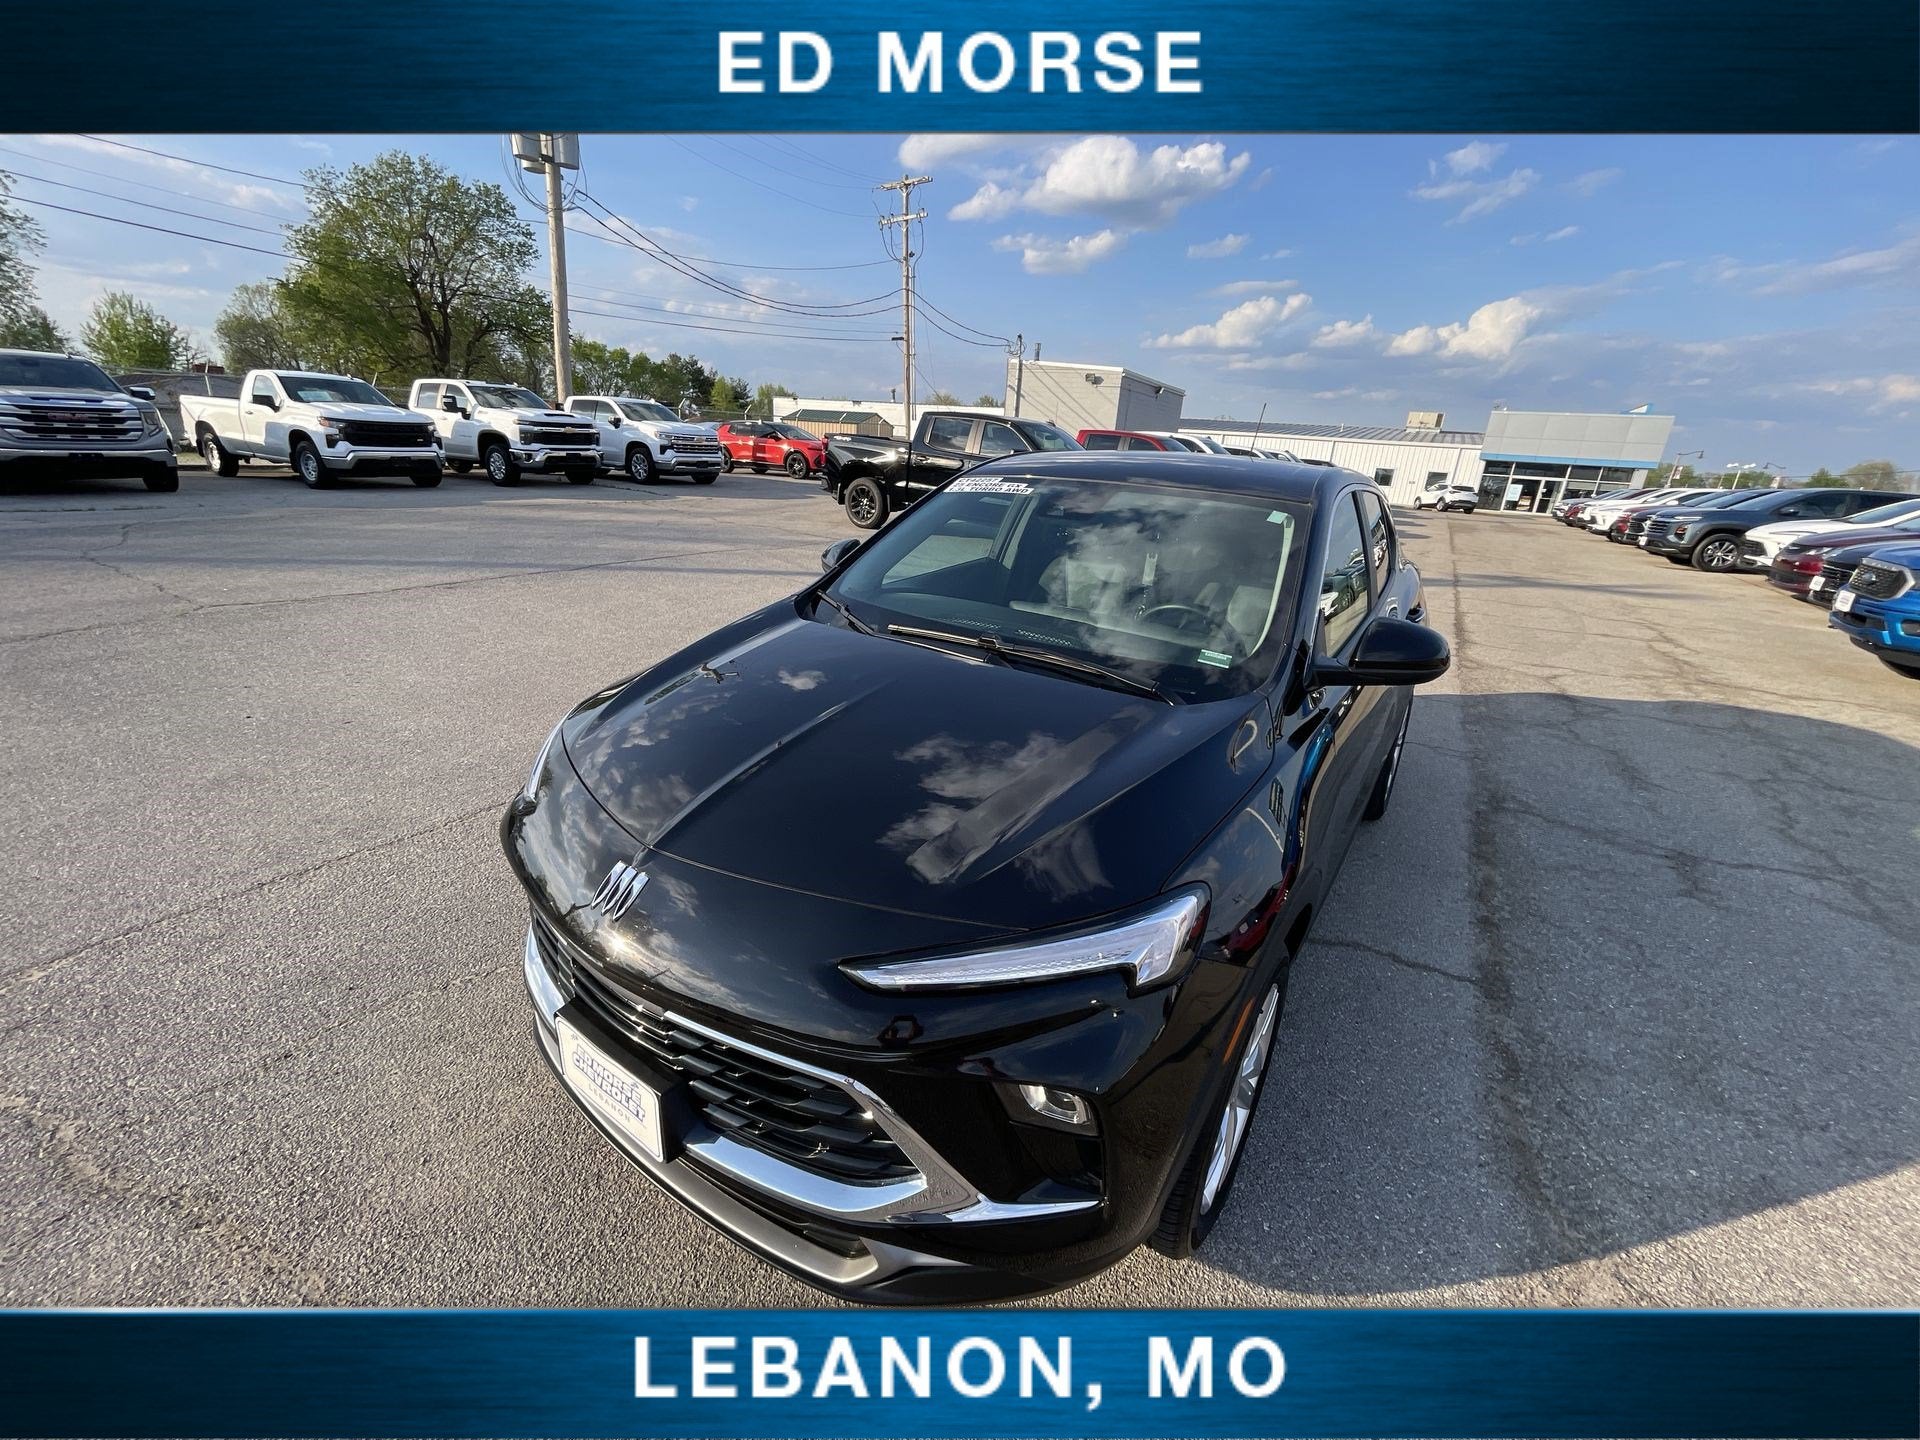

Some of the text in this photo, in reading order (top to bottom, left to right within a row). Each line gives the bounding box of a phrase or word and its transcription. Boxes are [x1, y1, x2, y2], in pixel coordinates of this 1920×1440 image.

[572, 1051, 646, 1123] CHEVROLET
[588, 1082, 631, 1123] LEBANON
[592, 1058, 642, 1107] MORSE
